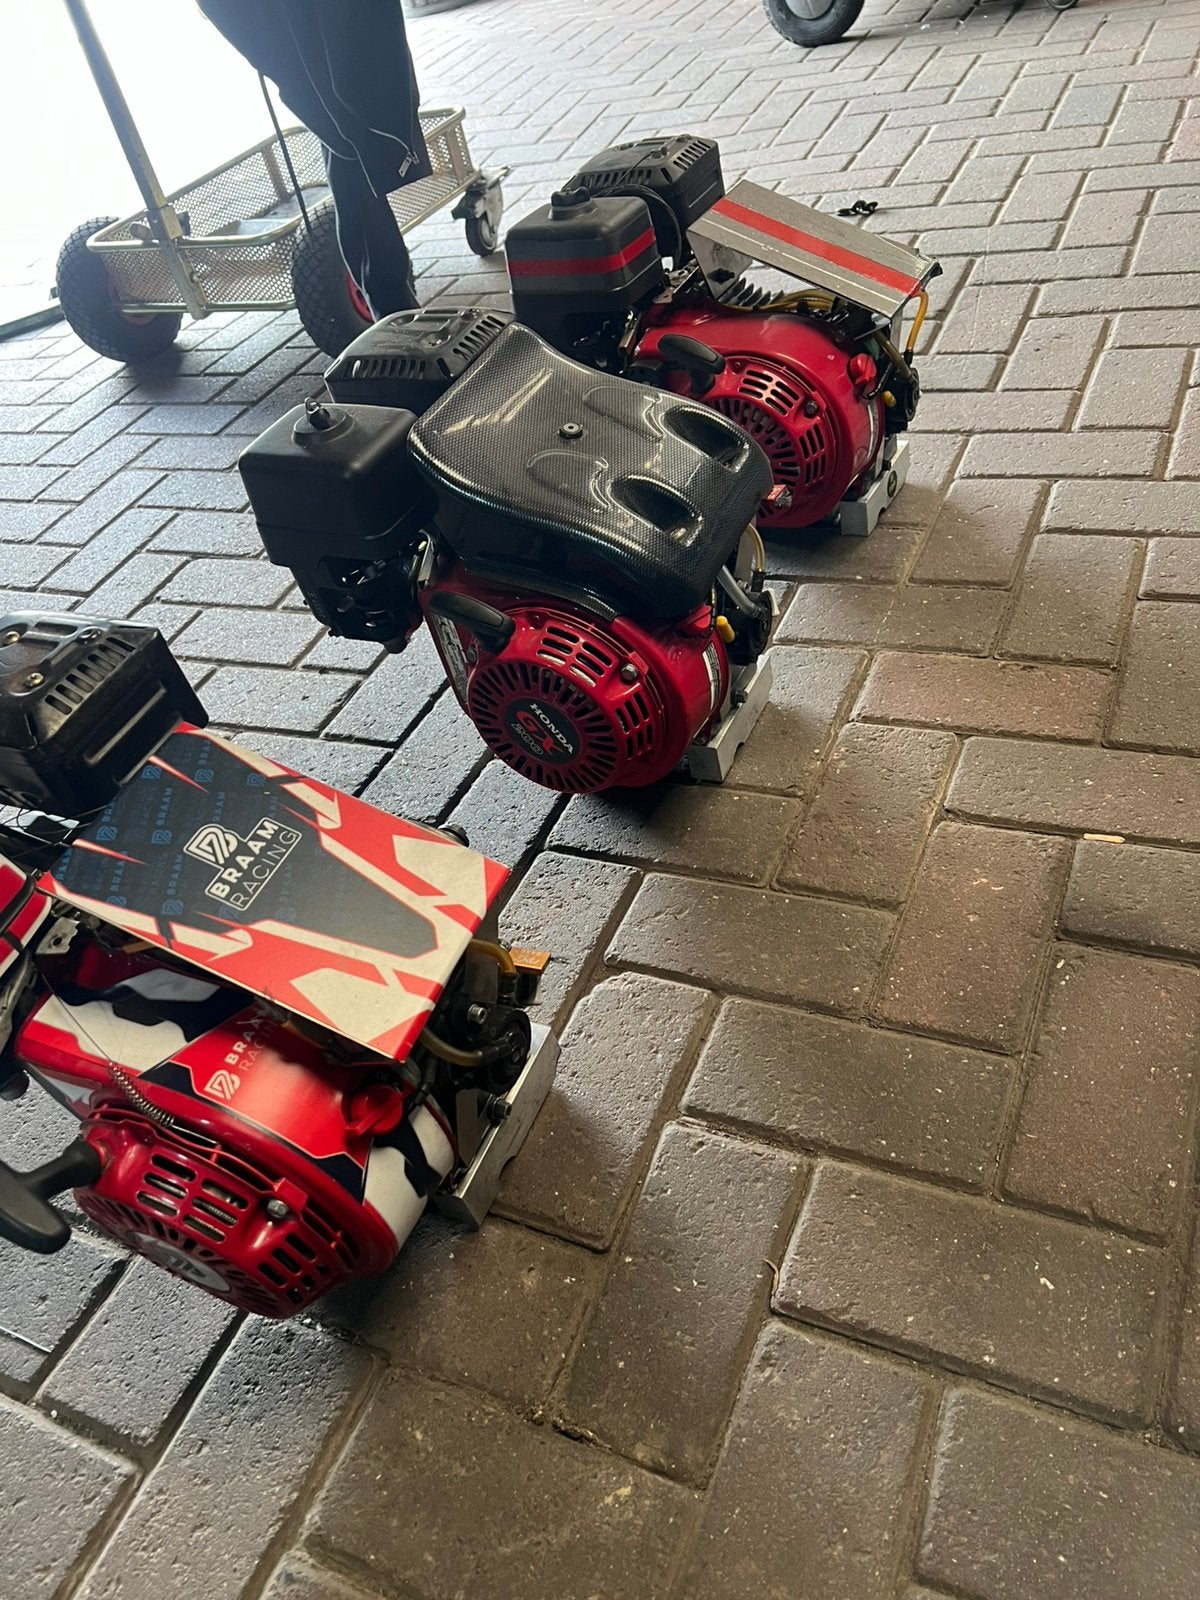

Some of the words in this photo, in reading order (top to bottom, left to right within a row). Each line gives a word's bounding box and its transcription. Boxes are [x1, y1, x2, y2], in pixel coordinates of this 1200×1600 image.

[516, 711, 565, 756] GX
[529, 703, 574, 754] HONDA
[155, 786, 174, 827] BRAAM
[211, 791, 226, 823] RAAM
[166, 853, 184, 896] BRAAM
[208, 820, 280, 899] BRAAM
[229, 830, 299, 908] RACING
[224, 1013, 264, 1066] BRAA
